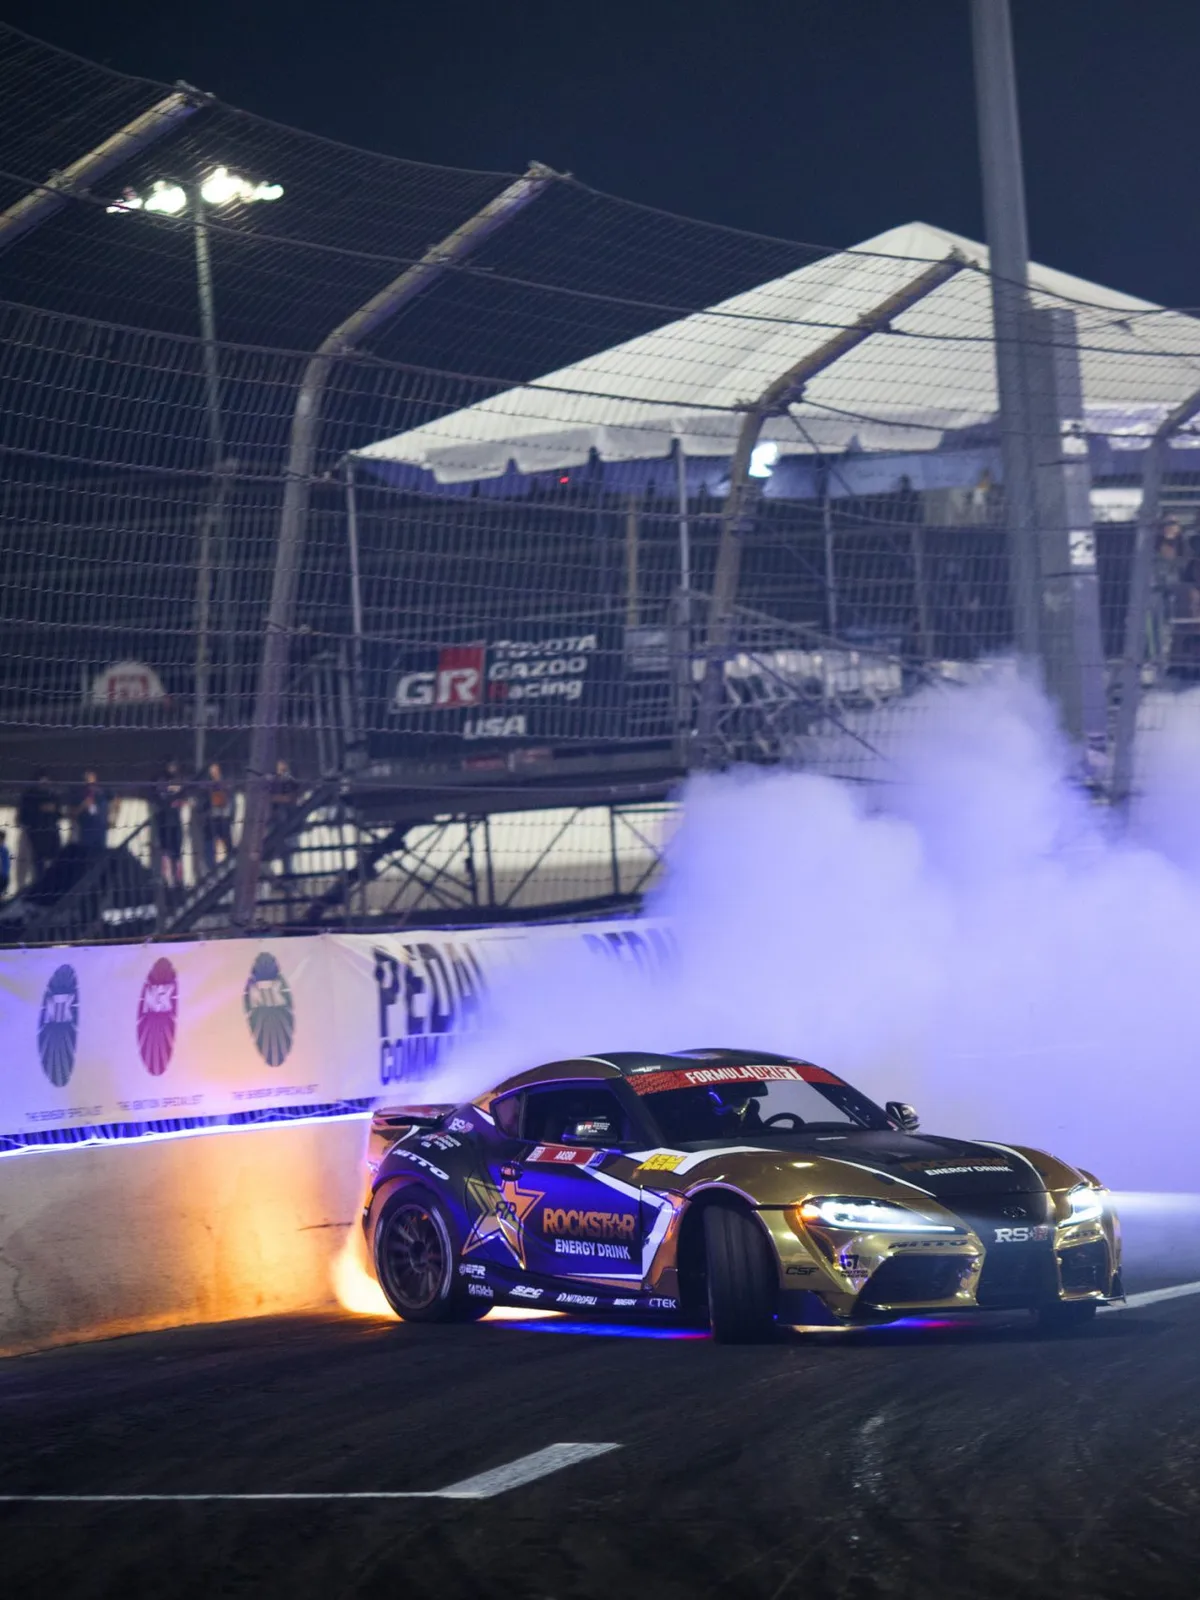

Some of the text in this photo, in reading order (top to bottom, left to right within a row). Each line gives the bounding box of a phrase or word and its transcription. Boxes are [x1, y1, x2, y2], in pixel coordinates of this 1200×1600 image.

[395, 667, 482, 706] GR
[463, 715, 526, 739] USA
[685, 1067, 751, 1084] FORMULA
[924, 1165, 1014, 1176] ENERGY DRINK
[543, 1207, 636, 1240] ROCKSTAR
[555, 1238, 631, 1260] ENERGY DRINK
[888, 1239, 969, 1250] NITTO
[785, 1265, 819, 1276] CSF
[649, 1297, 677, 1309] CTEK
